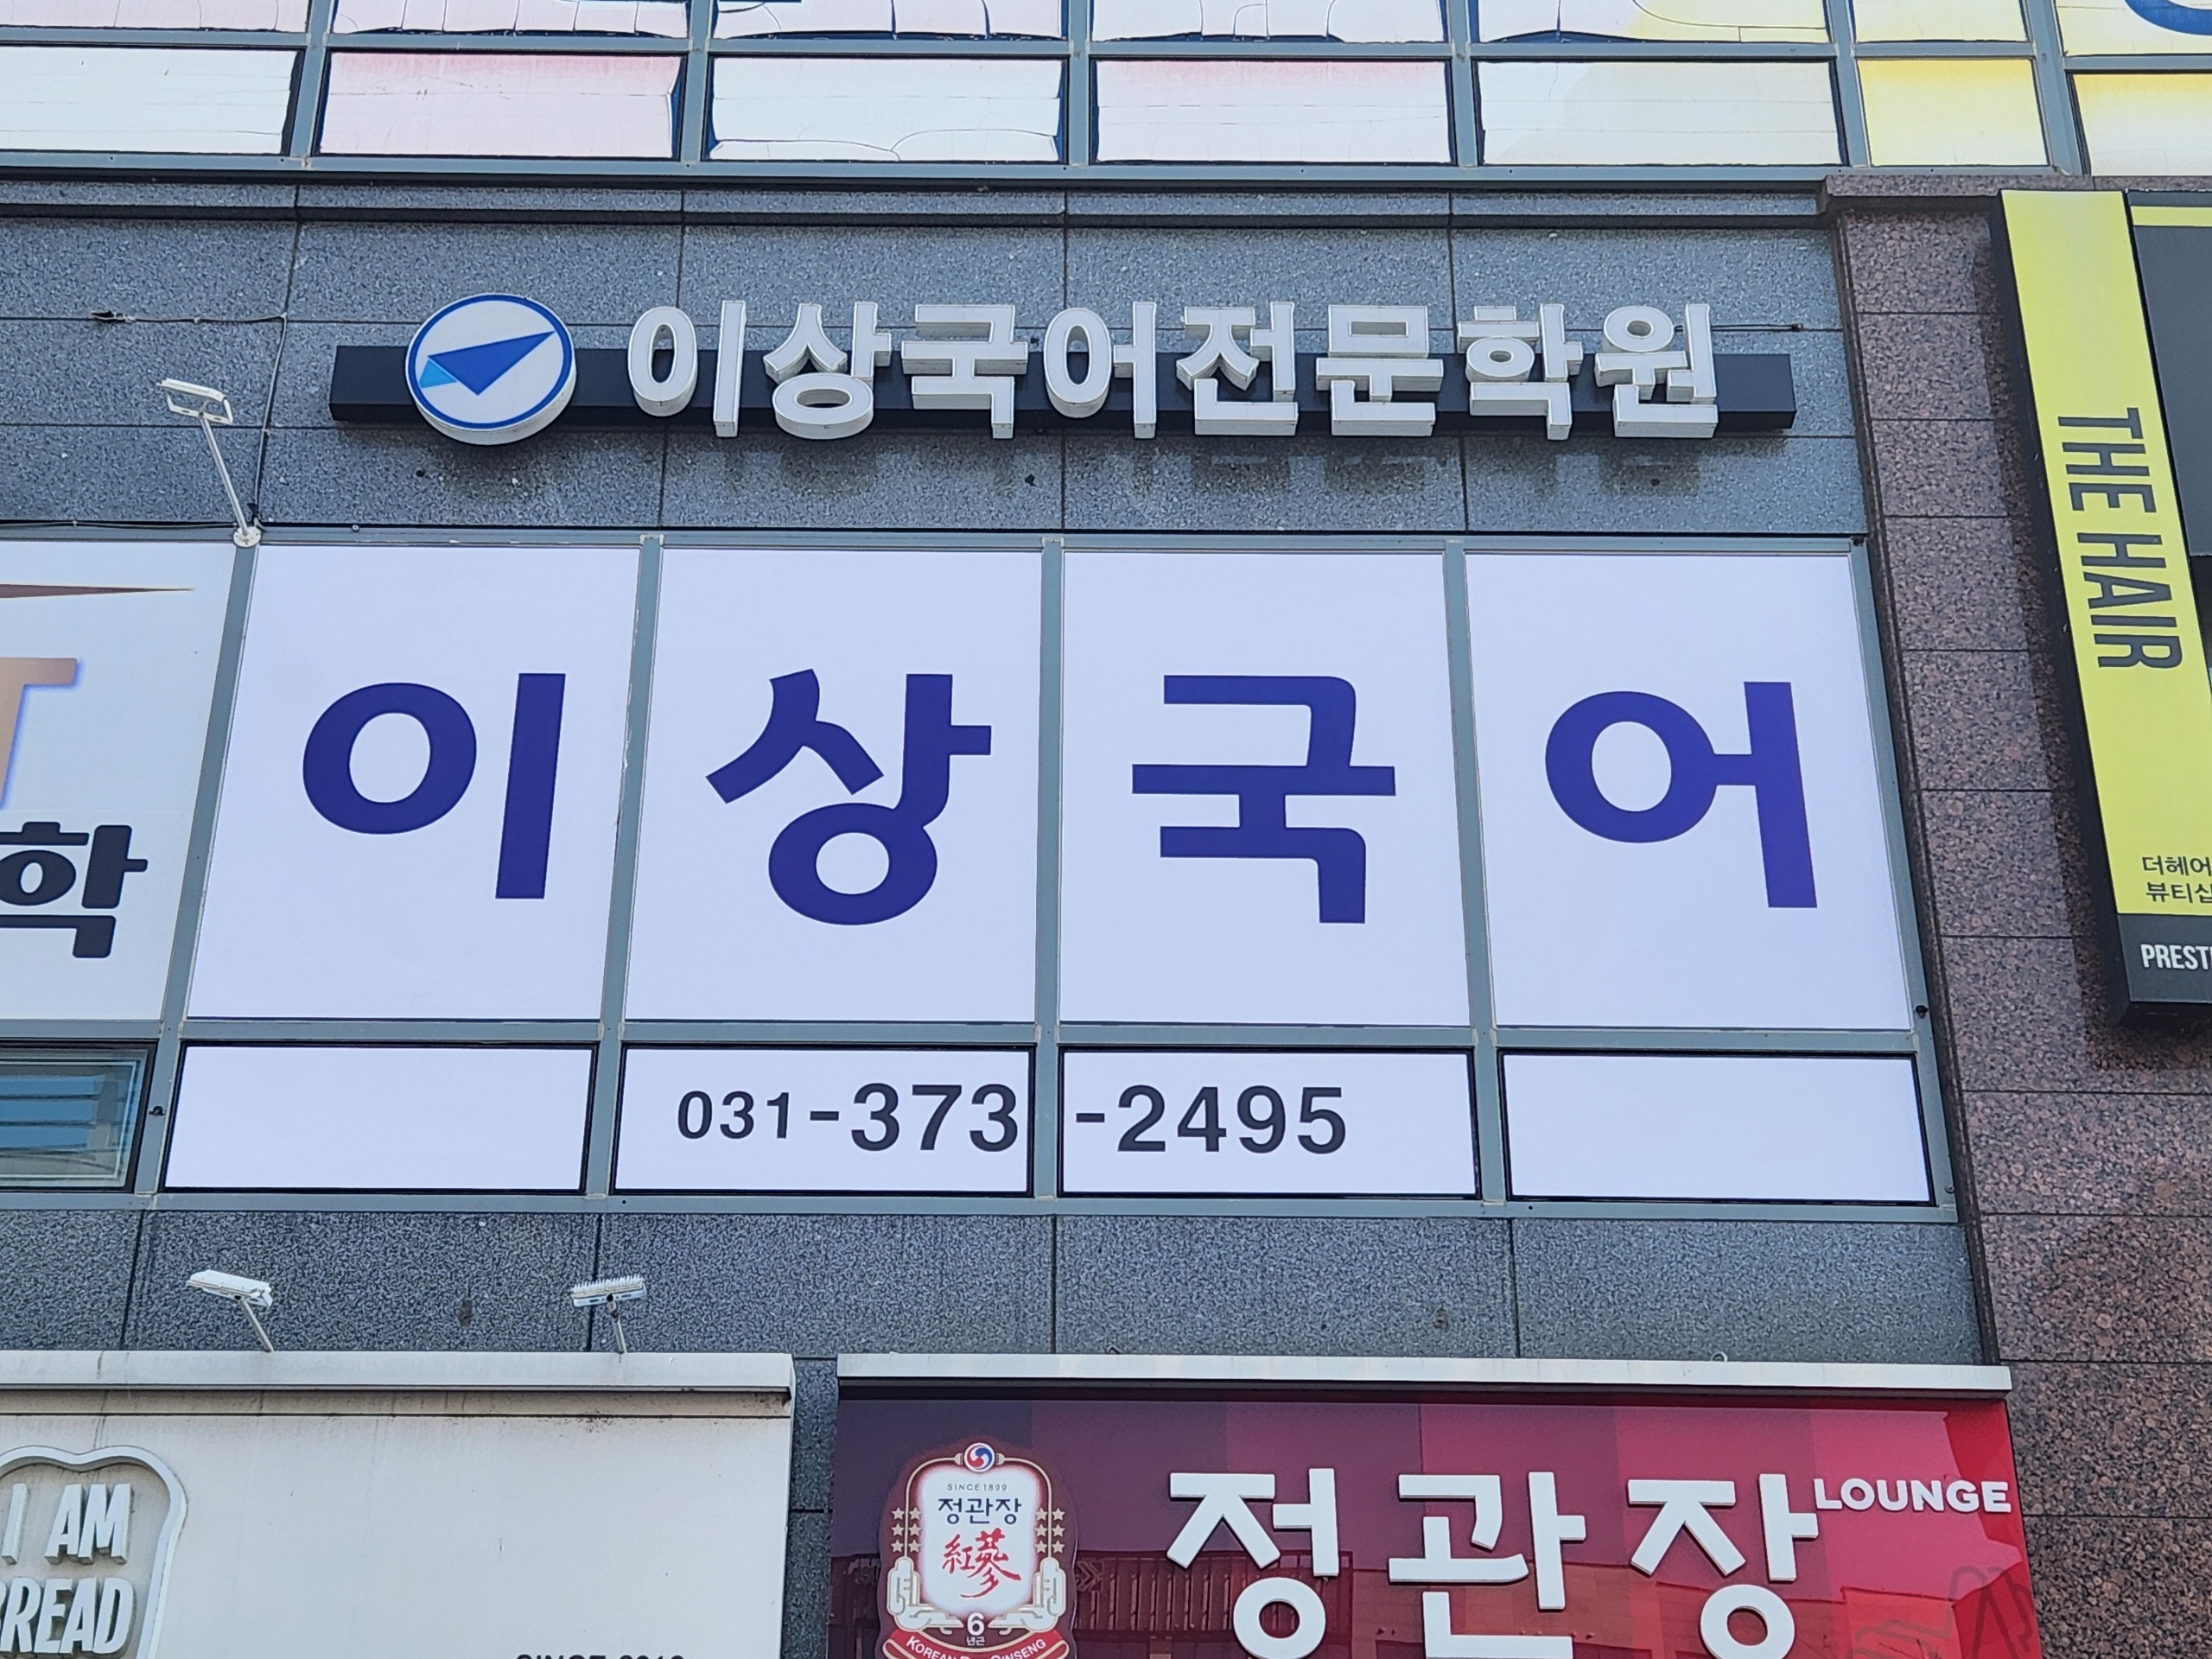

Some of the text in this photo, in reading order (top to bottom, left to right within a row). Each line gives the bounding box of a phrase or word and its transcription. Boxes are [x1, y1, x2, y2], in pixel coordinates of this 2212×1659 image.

[628, 300, 1718, 441] 이상국어전문학원
[2057, 407, 2183, 669] THE HAIR
[302, 669, 1818, 926] 이상국어
[0, 822, 148, 958] 학
[2142, 855, 2212, 877] 더헤어
[2140, 944, 2212, 970] PREST
[1, 1483, 130, 1565] I AM
[938, 1497, 1022, 1525] 정관장
[946, 1483, 981, 1491] SINCE
[1814, 1478, 2012, 1513] LOUNGE
[1166, 1467, 1819, 1659] 정관장
[0, 1577, 135, 1656] READ
[967, 1612, 985, 1636] 6
